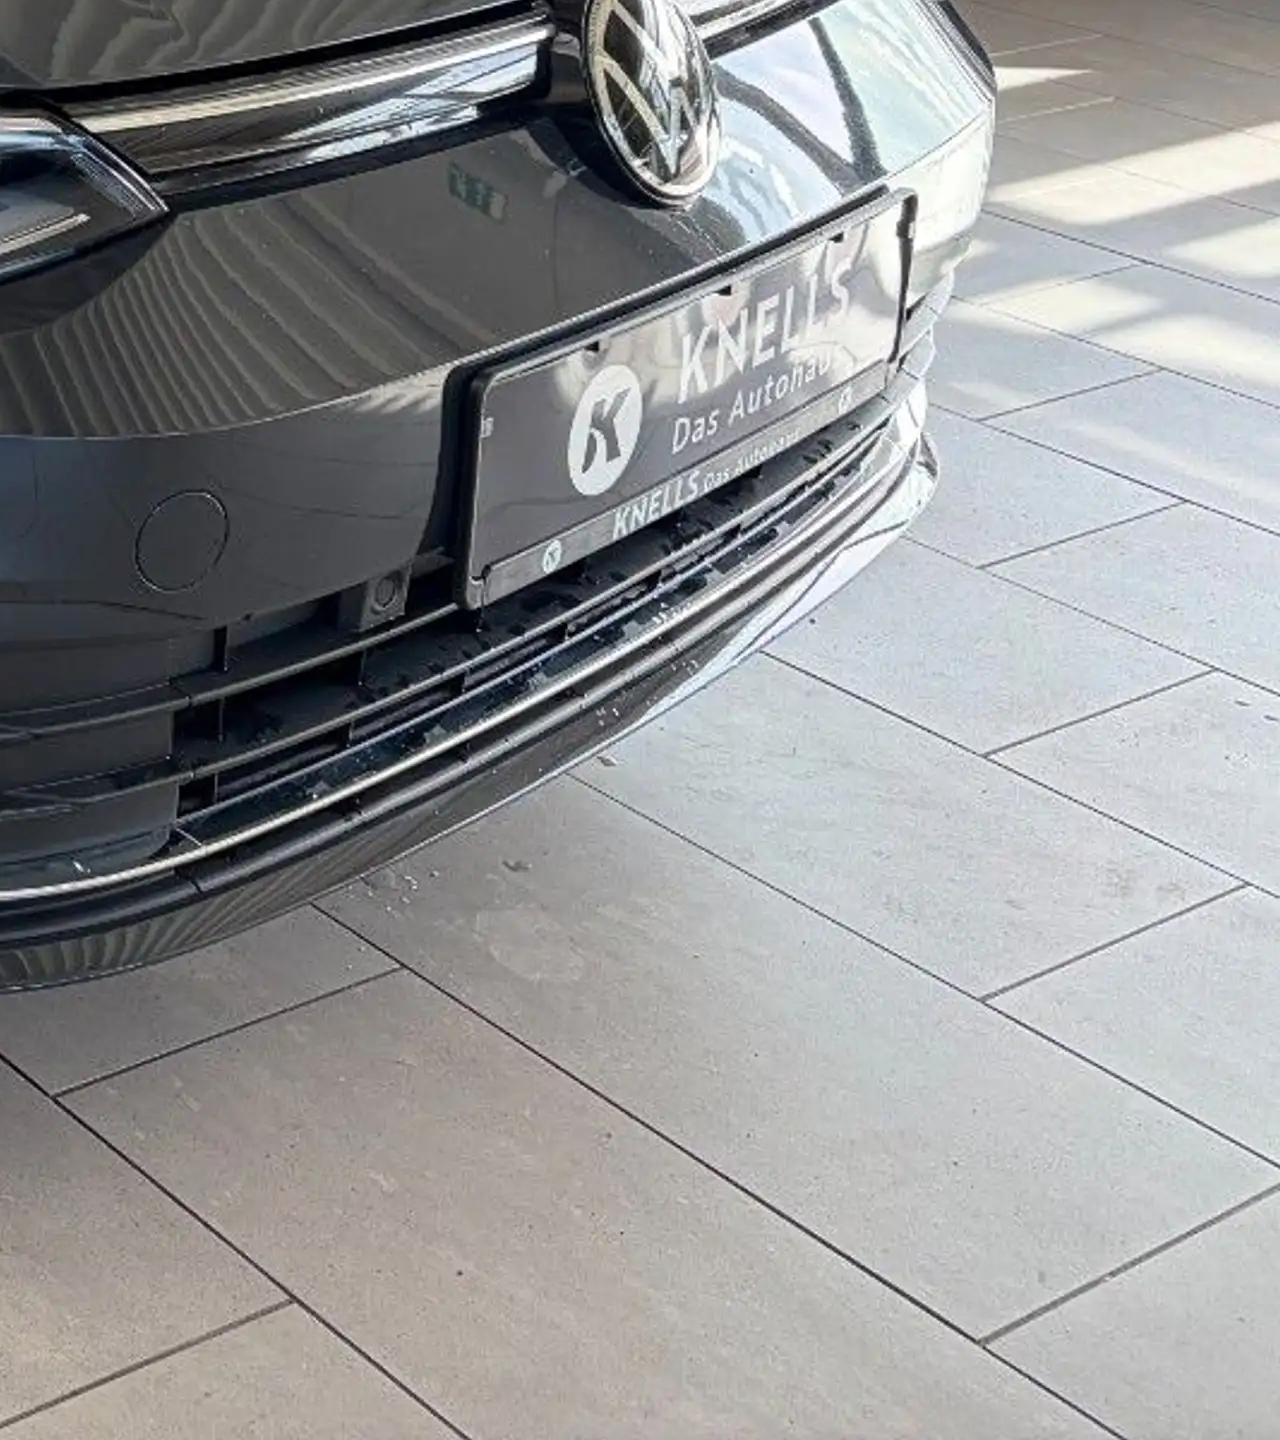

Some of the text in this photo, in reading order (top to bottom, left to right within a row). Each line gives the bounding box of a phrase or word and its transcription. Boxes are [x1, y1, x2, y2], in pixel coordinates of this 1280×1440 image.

[677, 255, 853, 405] KNELLS
[671, 409, 720, 455] Das
[612, 469, 700, 541] KNELLS
